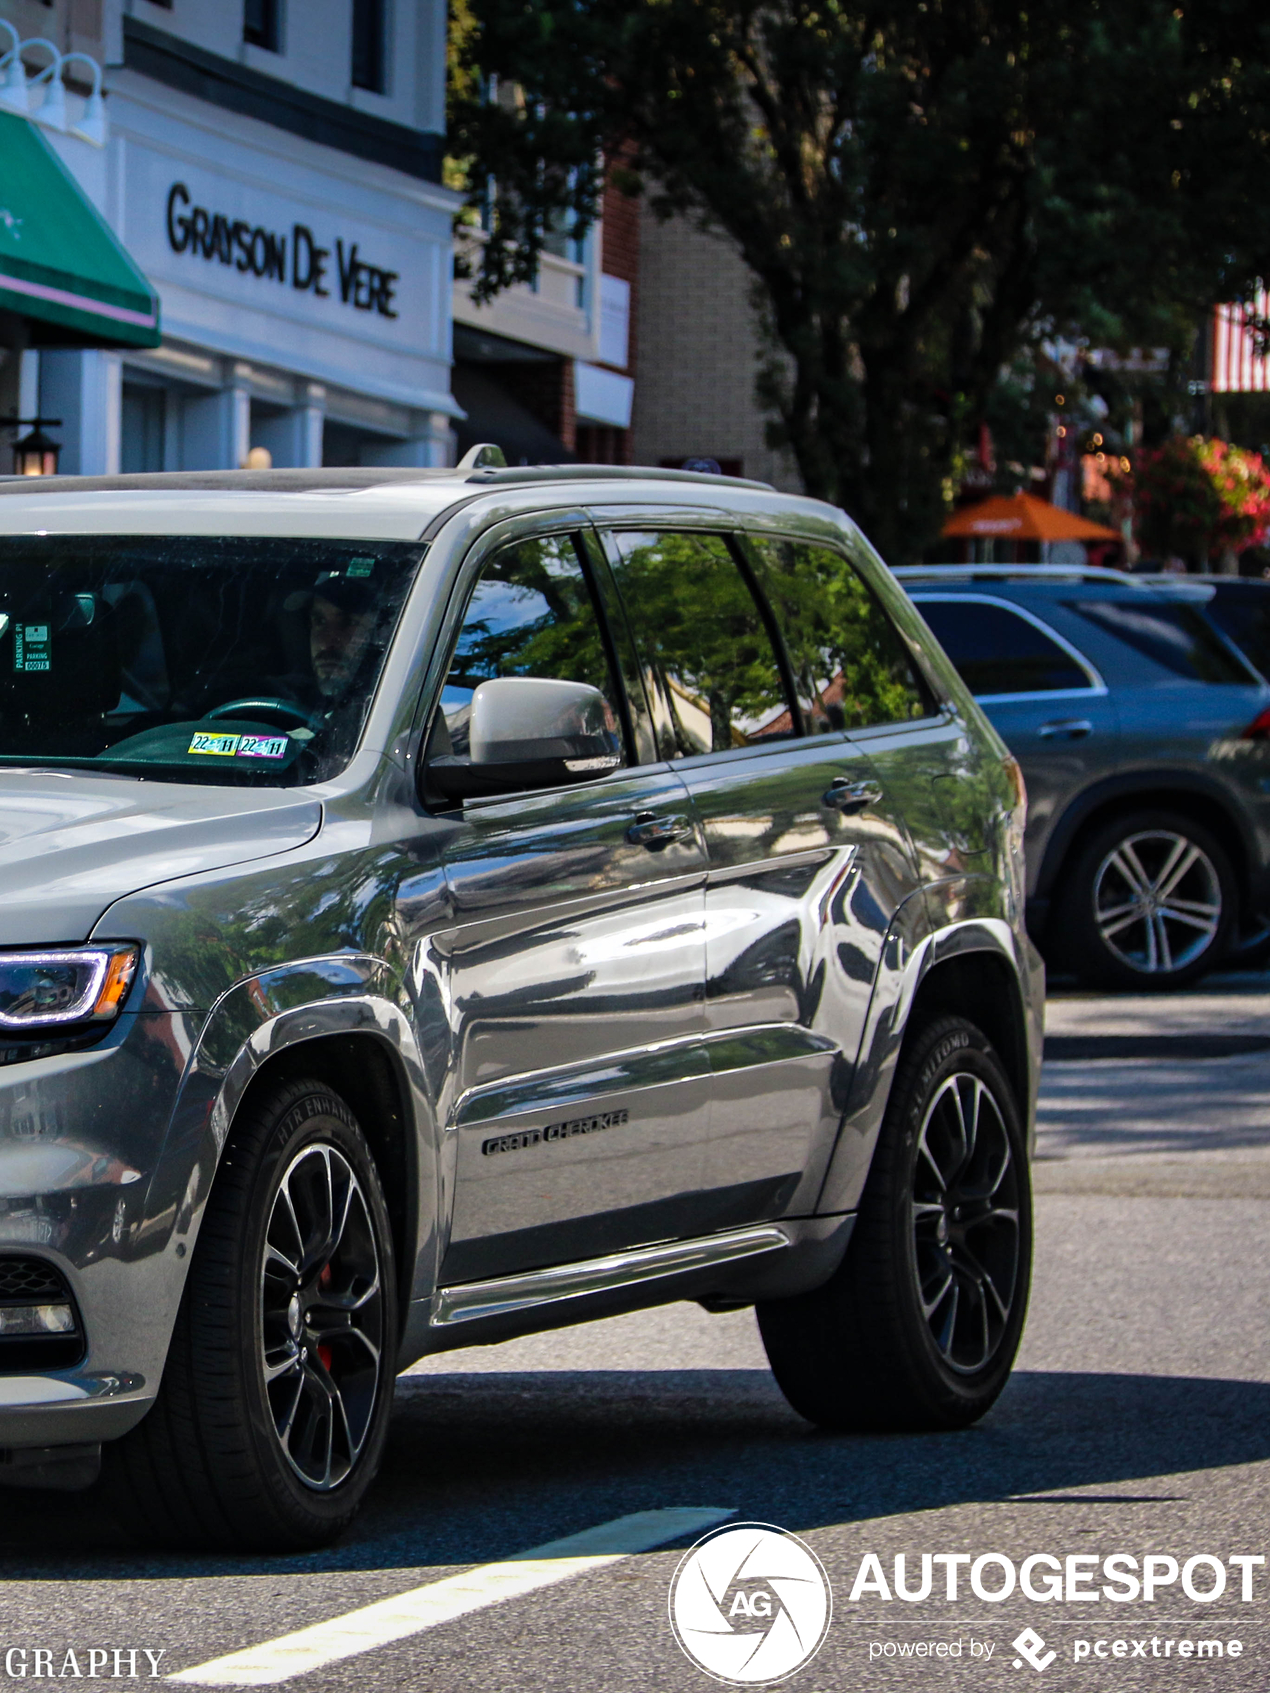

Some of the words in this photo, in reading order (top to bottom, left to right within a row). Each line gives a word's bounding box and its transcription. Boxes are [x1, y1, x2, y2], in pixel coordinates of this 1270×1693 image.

[166, 180, 287, 283] GRAYSON
[193, 735, 210, 750] 22
[240, 738, 258, 752] 22
[276, 1109, 304, 1146] HTR
[481, 1128, 542, 1156] GRAND
[543, 1108, 630, 1142] CHEROKEE
